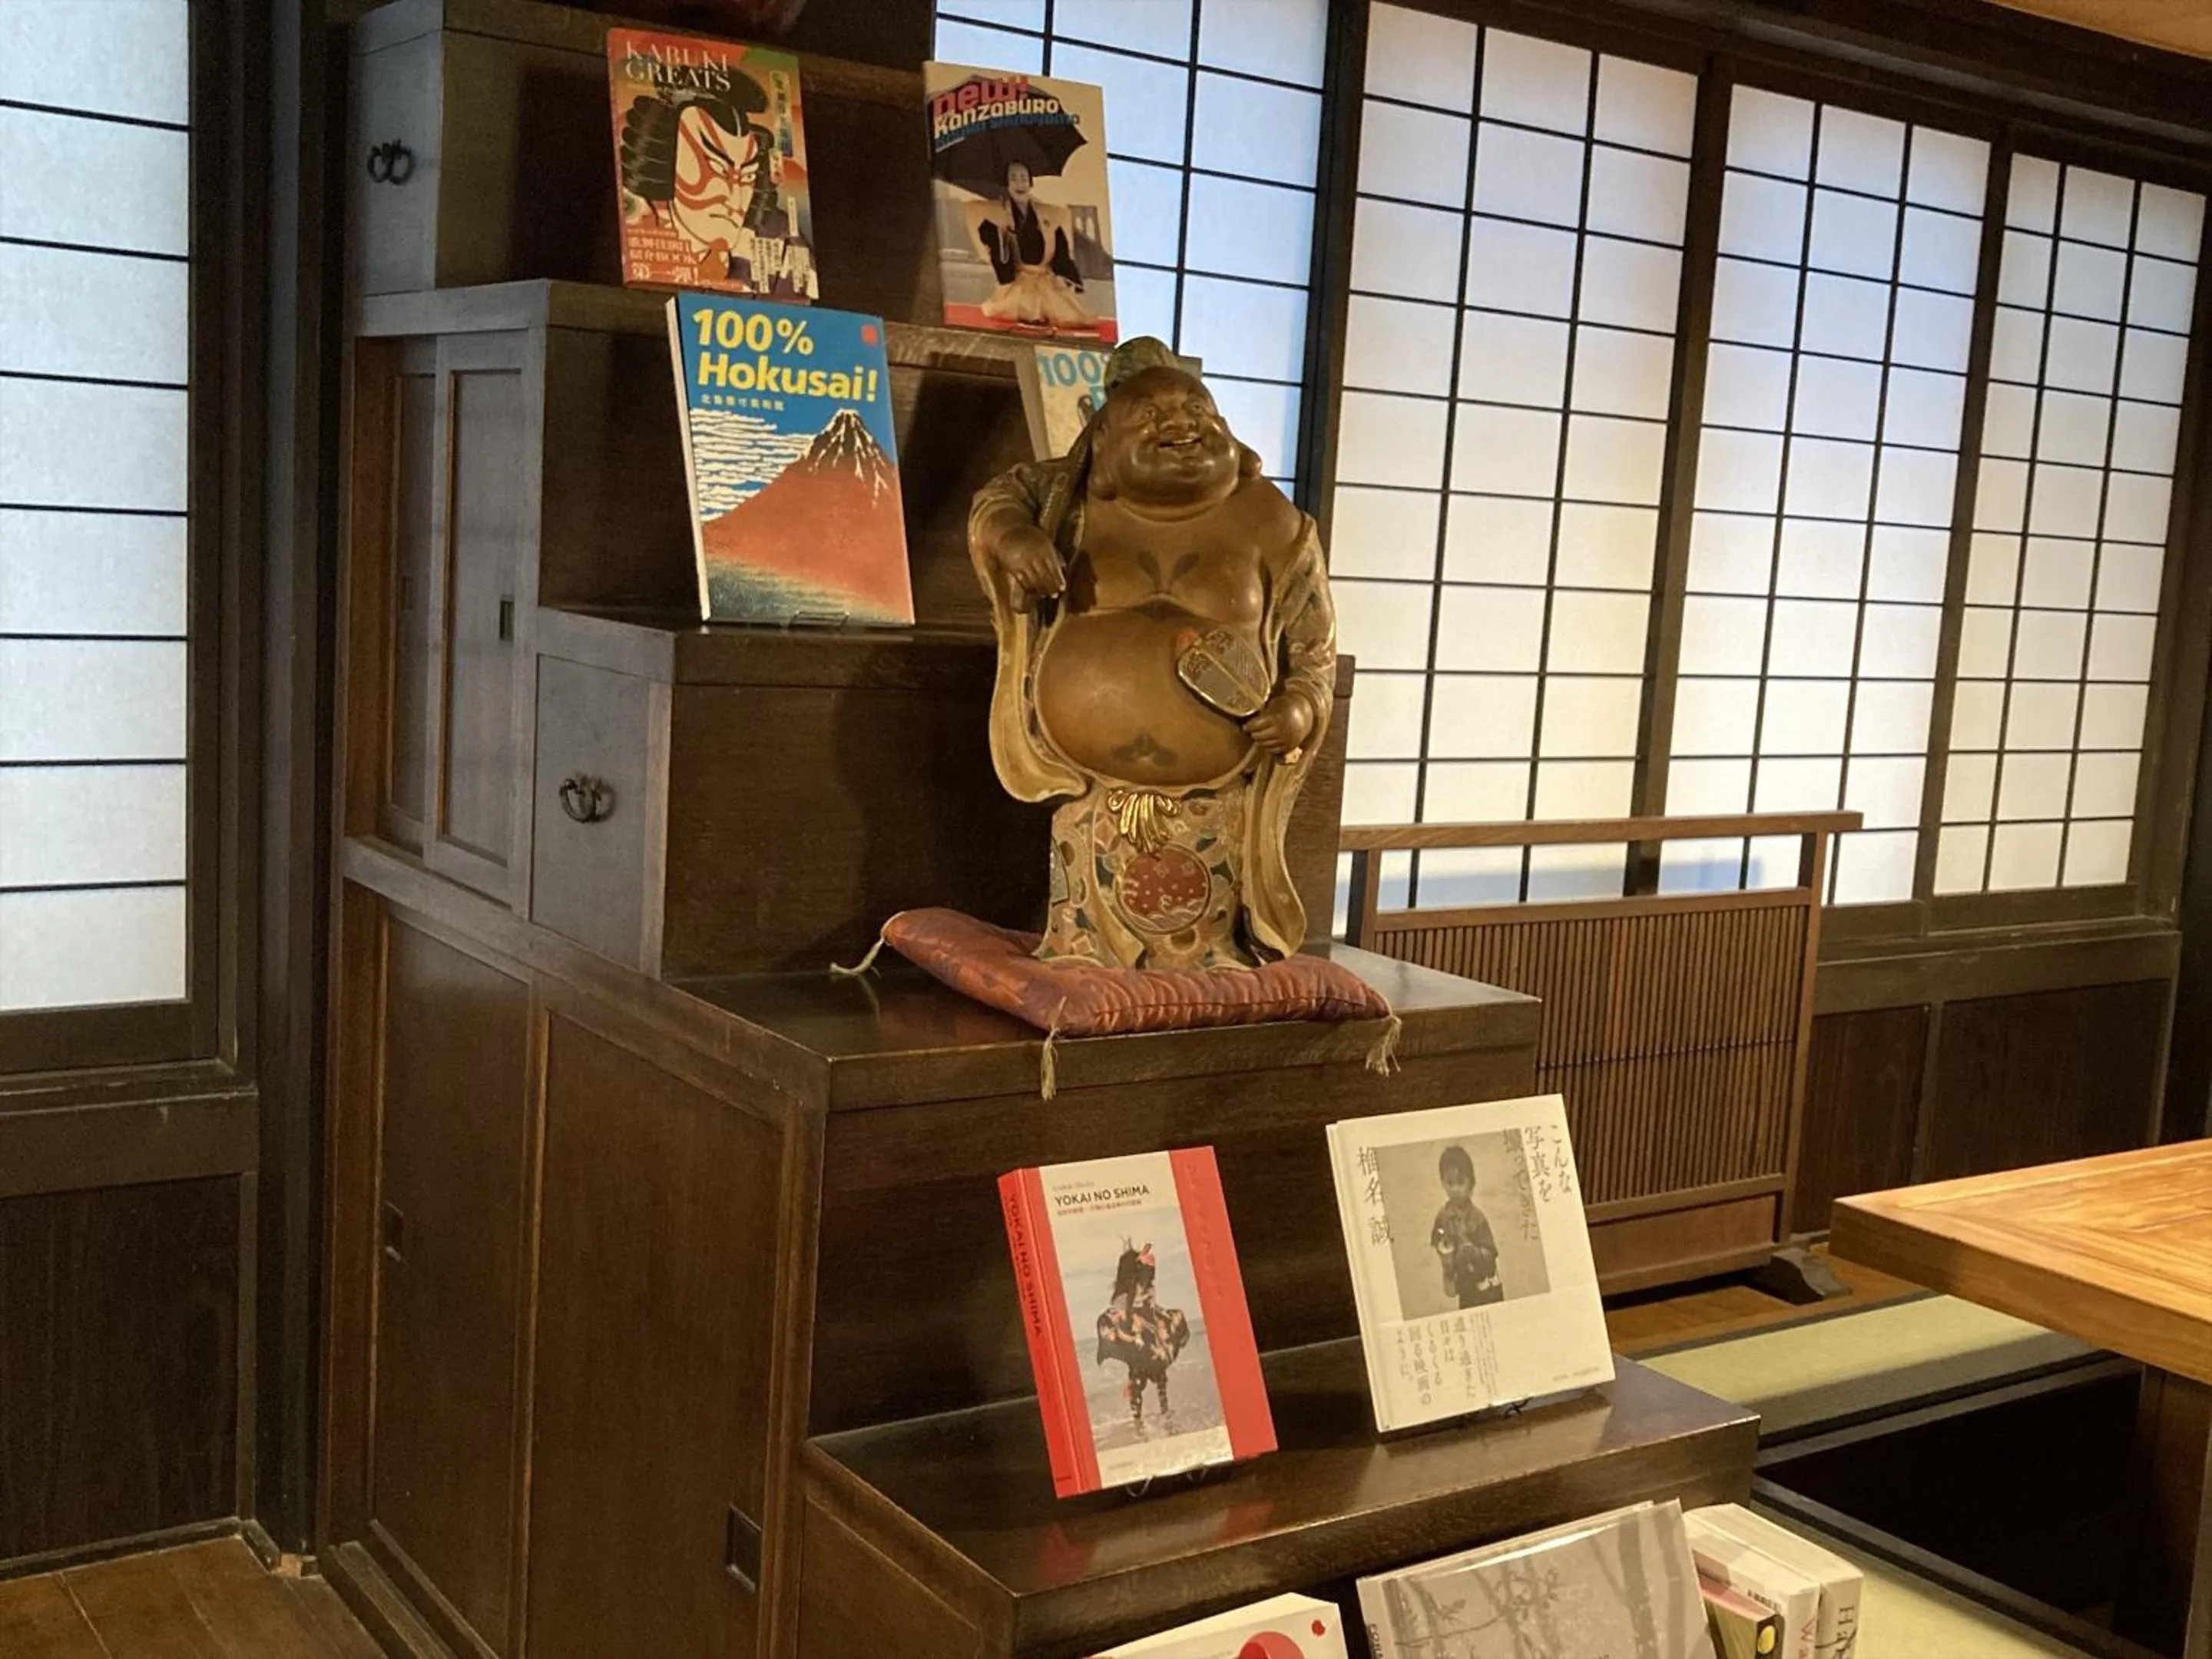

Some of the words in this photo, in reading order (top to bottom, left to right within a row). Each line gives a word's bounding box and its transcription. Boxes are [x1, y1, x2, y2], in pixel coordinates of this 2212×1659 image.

[625, 61, 731, 93] GREATS
[626, 40, 728, 72] KABUKI
[693, 308, 815, 356] 100%
[697, 351, 879, 402] Hokusai!
[1525, 1125, 1553, 1203] 写真を
[1054, 1191, 1092, 1207] YOKAI
[1094, 1189, 1111, 1201] NO
[1113, 1184, 1150, 1199] SHIMA
[1009, 1193, 1025, 1247] YOKAI
[1021, 1250, 1031, 1278] NO
[1025, 1281, 1041, 1337] SHIMA
